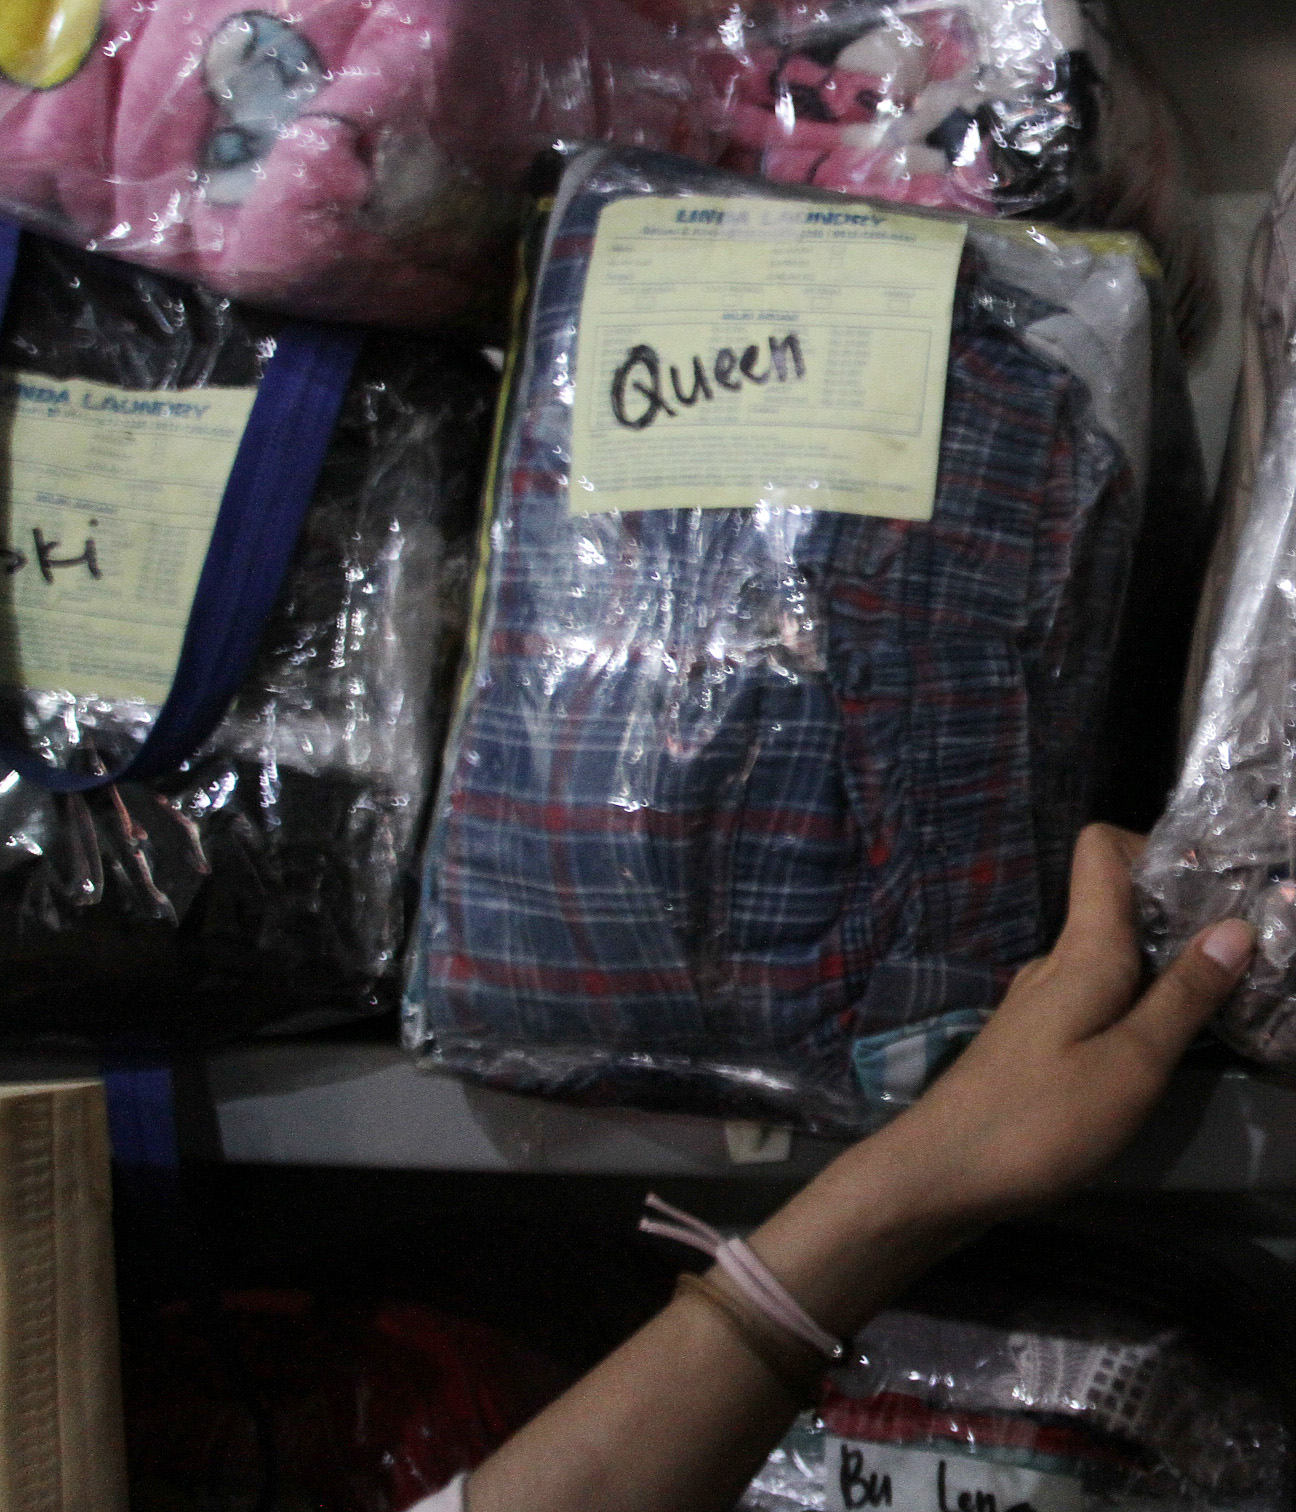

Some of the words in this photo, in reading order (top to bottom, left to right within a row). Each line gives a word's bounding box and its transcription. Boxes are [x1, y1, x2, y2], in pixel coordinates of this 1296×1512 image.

[82, 391, 212, 420] LAUNDRY
[610, 332, 805, 430] Queen
[840, 1444, 893, 1510] Bu
